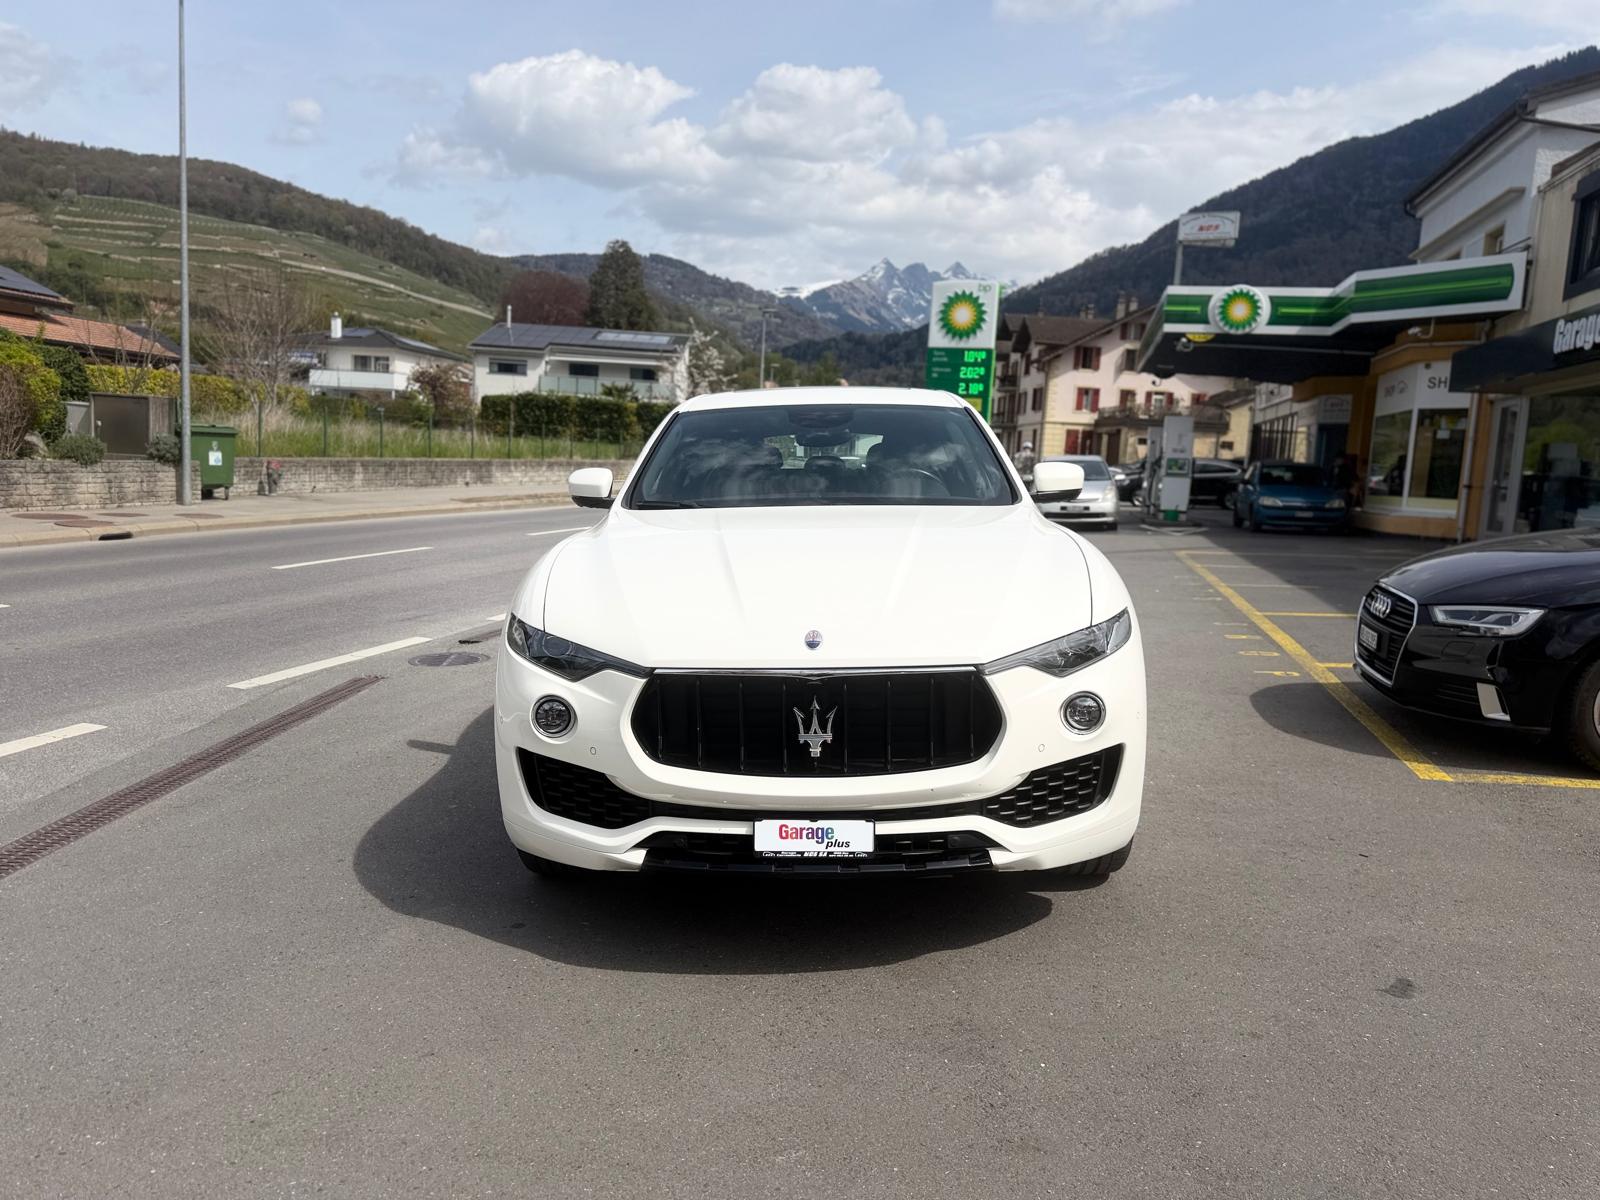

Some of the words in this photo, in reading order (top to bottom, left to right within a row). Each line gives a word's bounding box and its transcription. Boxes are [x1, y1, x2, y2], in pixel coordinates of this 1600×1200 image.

[978, 283, 992, 294] bp
[778, 823, 835, 844] Garage
[825, 839, 851, 850] plus
